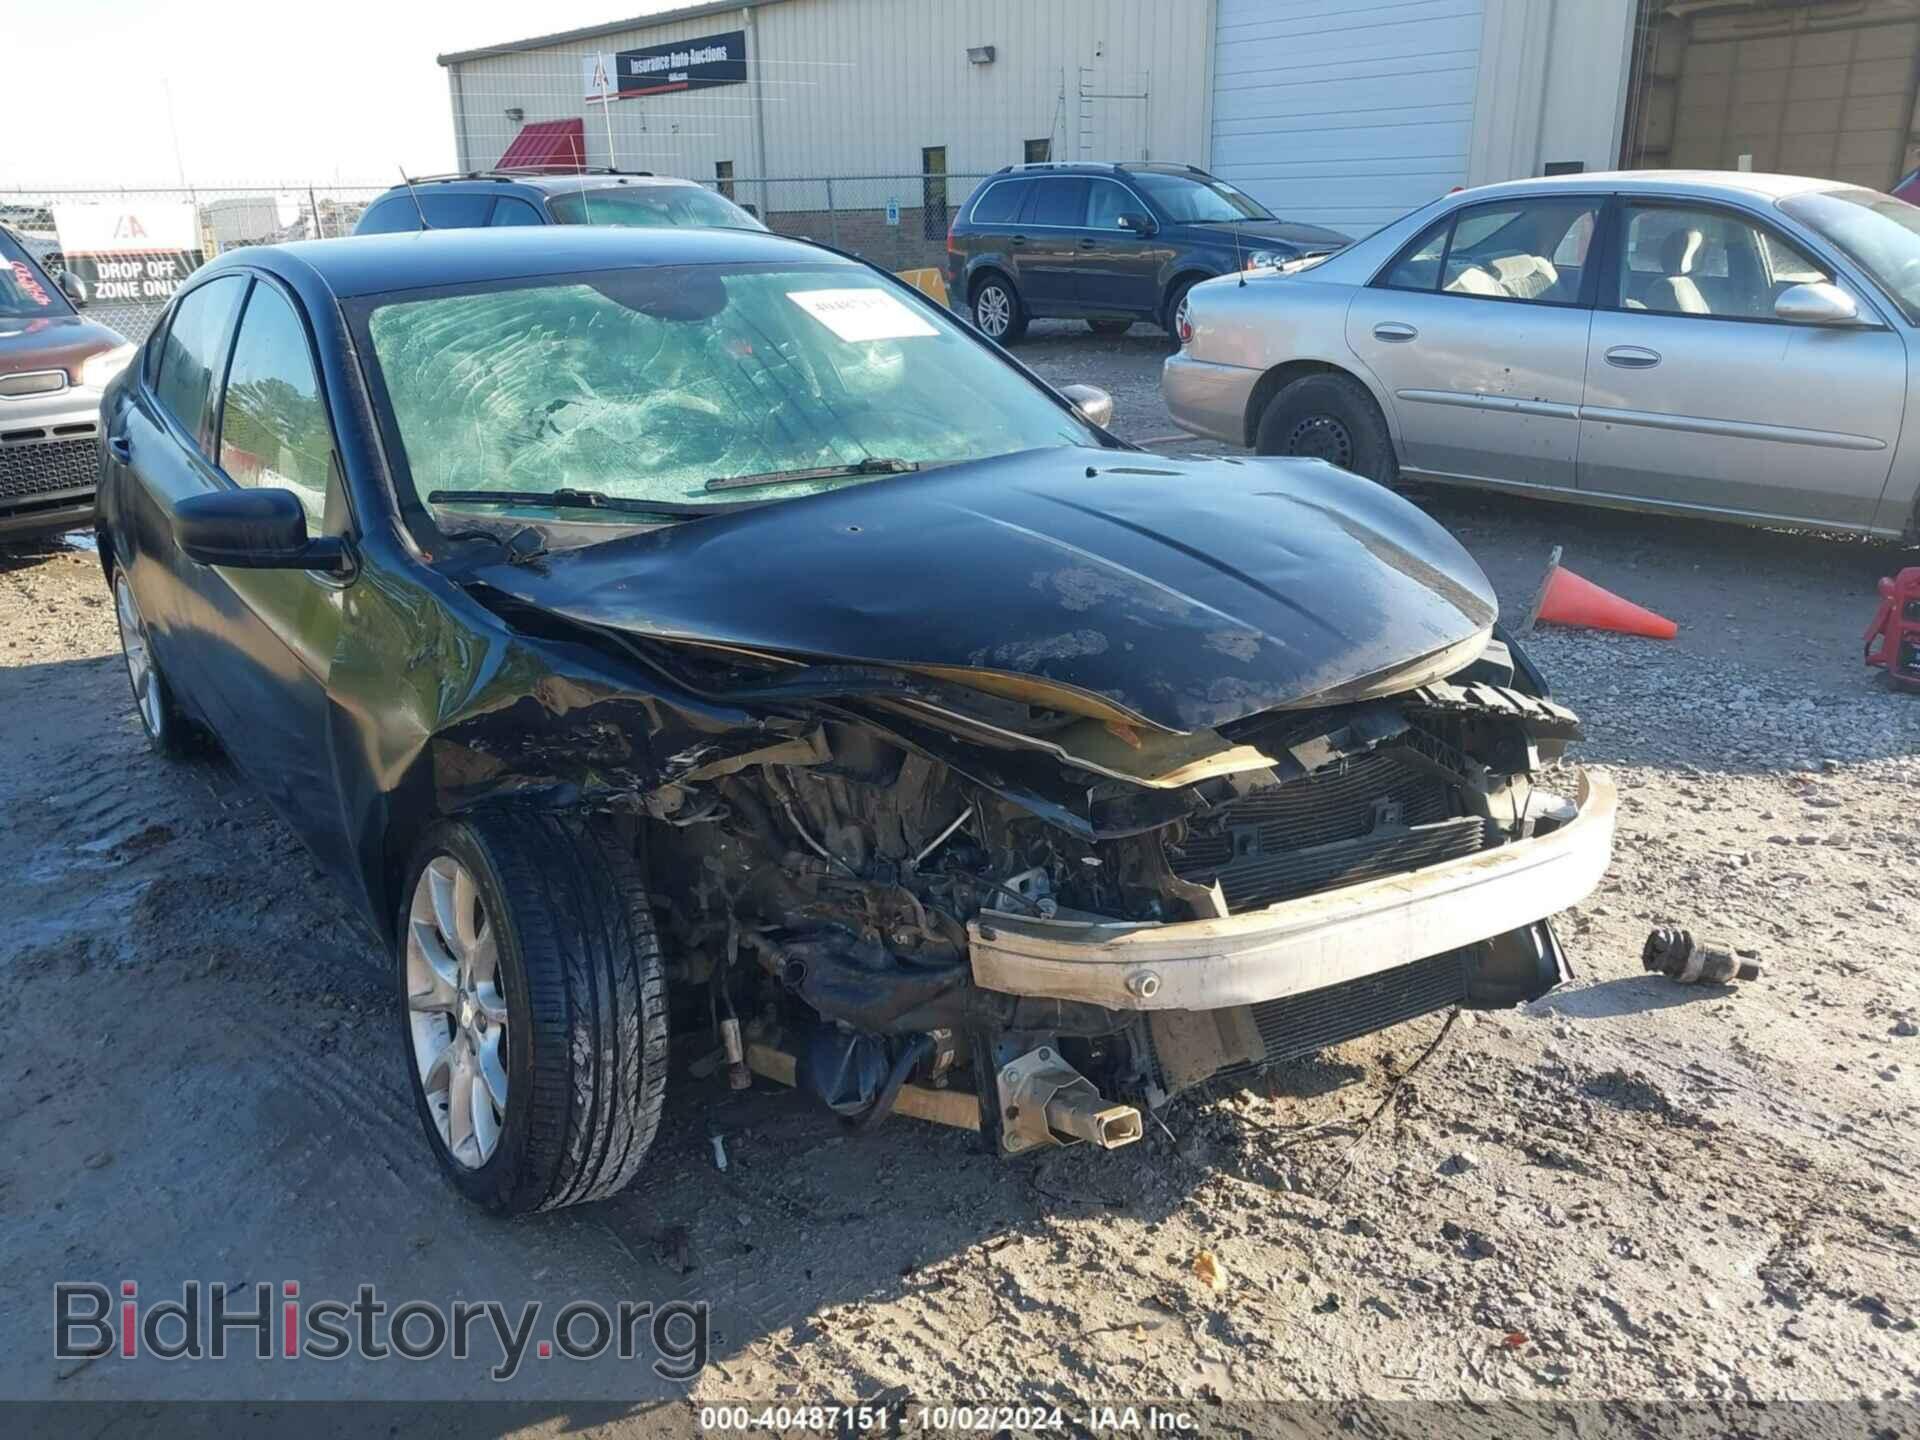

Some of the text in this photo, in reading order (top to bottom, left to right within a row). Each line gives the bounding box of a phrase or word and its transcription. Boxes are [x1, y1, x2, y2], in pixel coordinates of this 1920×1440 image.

[630, 45, 728, 74] Insurance Auto Auctions
[97, 260, 176, 279] DROP OFF
[94, 281, 142, 299] ZONE
